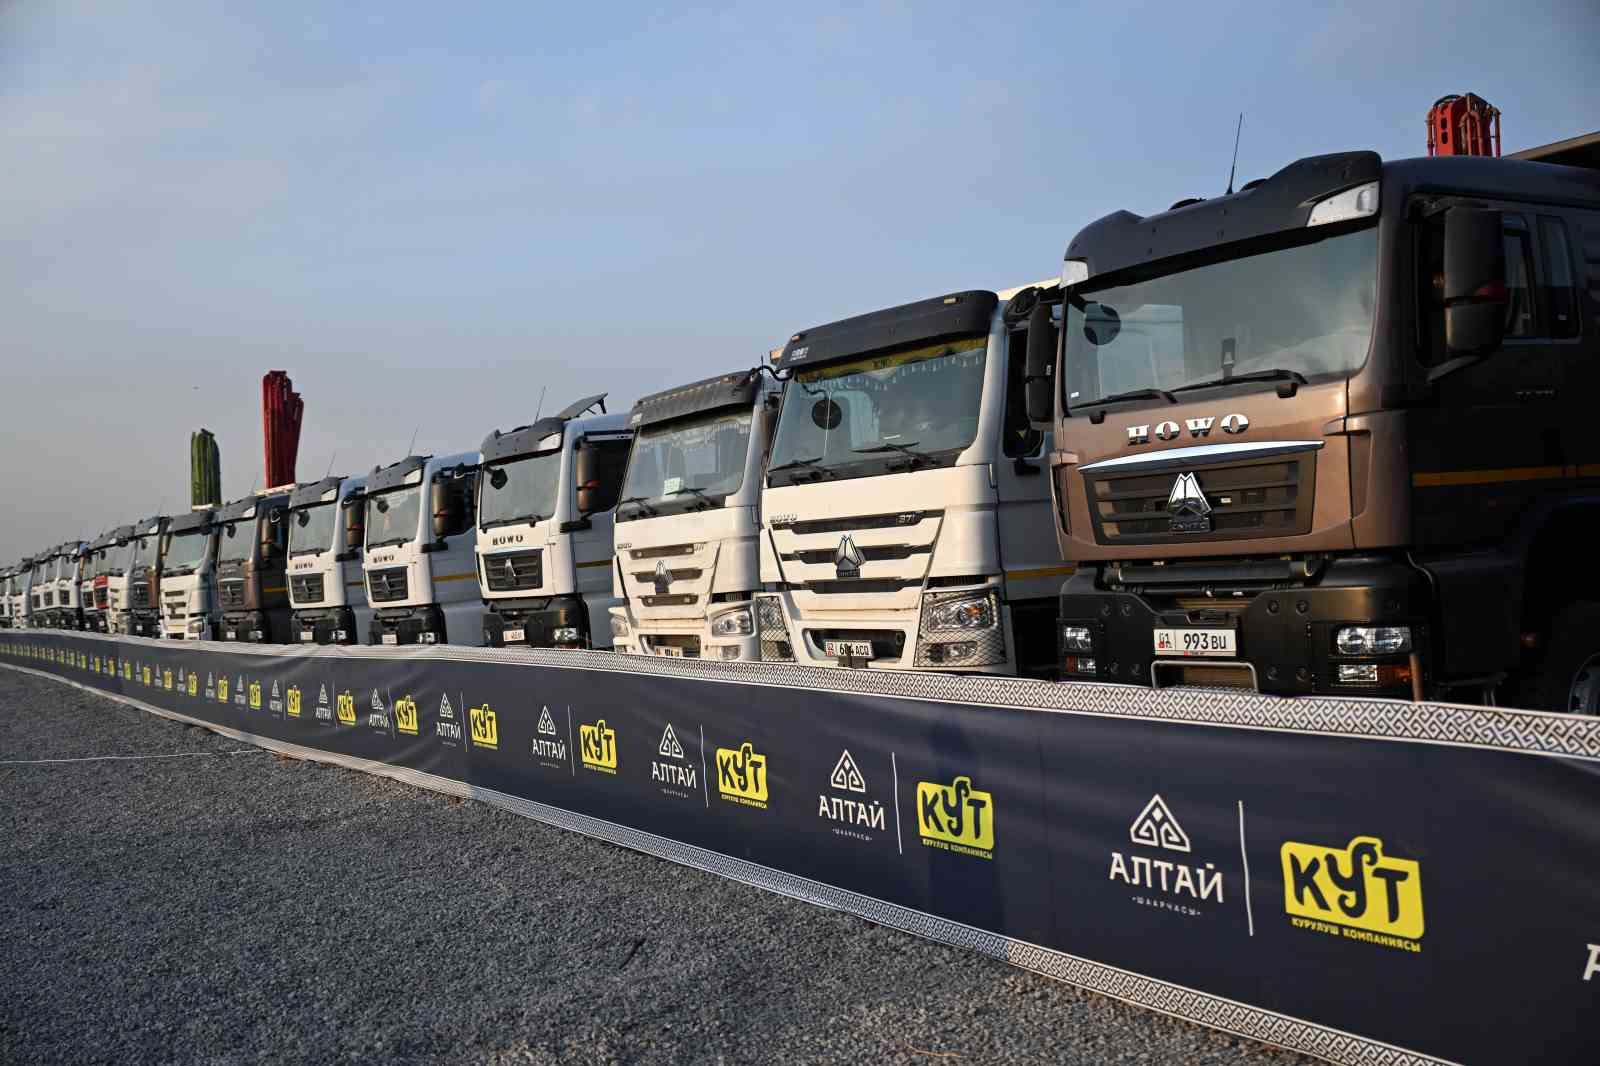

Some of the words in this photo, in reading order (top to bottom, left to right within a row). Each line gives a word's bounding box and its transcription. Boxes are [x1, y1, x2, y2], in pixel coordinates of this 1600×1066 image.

[1126, 413, 1249, 447] HOWO
[436, 721, 461, 740] АЛТАЙ
[472, 705, 495, 740] КУТ
[532, 738, 566, 761] АЛТАЙ
[582, 721, 613, 763] КУТ
[652, 761, 697, 789] АЛТАЙ
[719, 745, 764, 793] КУТ
[819, 795, 886, 831] АЛТАЙ
[921, 779, 987, 840] КУТ
[1108, 851, 1224, 904] АЛТАЙ
[1289, 842, 1409, 924] КУТ
[1290, 917, 1340, 936] КУРУЛУШ
[1342, 927, 1421, 953] КОМПАНИЯСЫ
